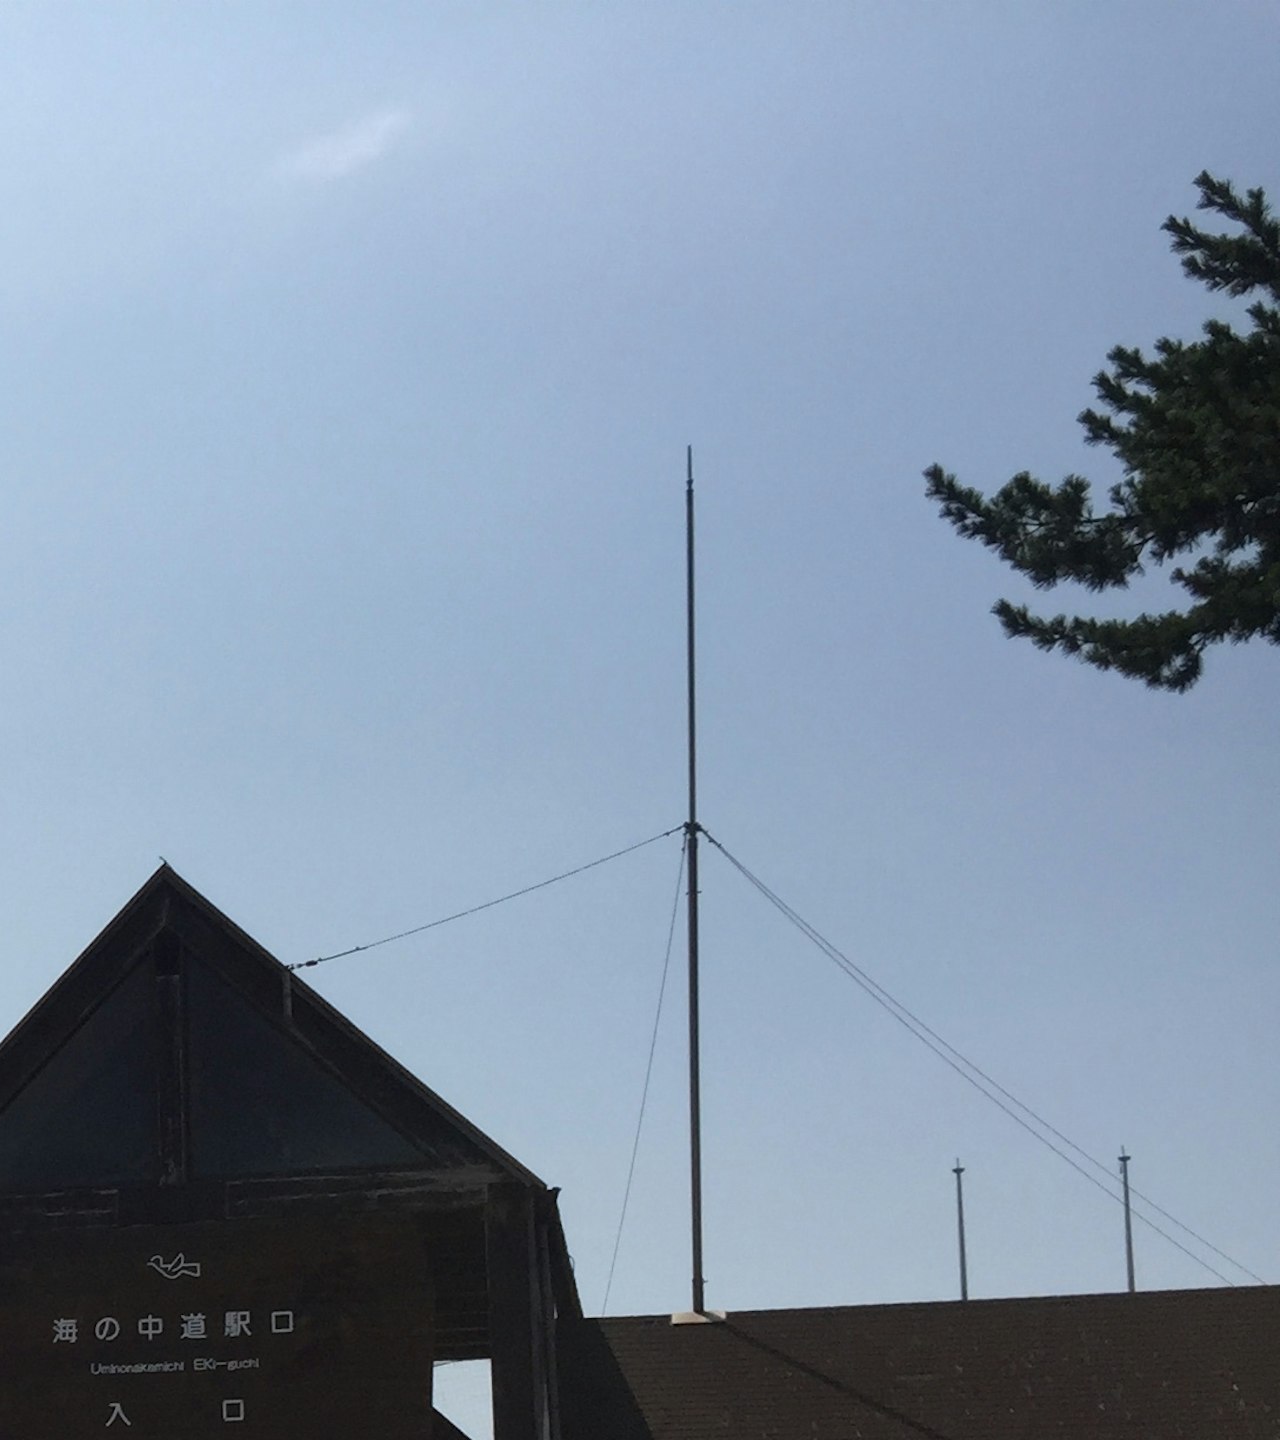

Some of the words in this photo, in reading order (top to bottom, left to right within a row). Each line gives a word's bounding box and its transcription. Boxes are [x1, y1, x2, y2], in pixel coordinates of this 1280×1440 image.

[52, 1310, 295, 1343] 海の中道駅口
